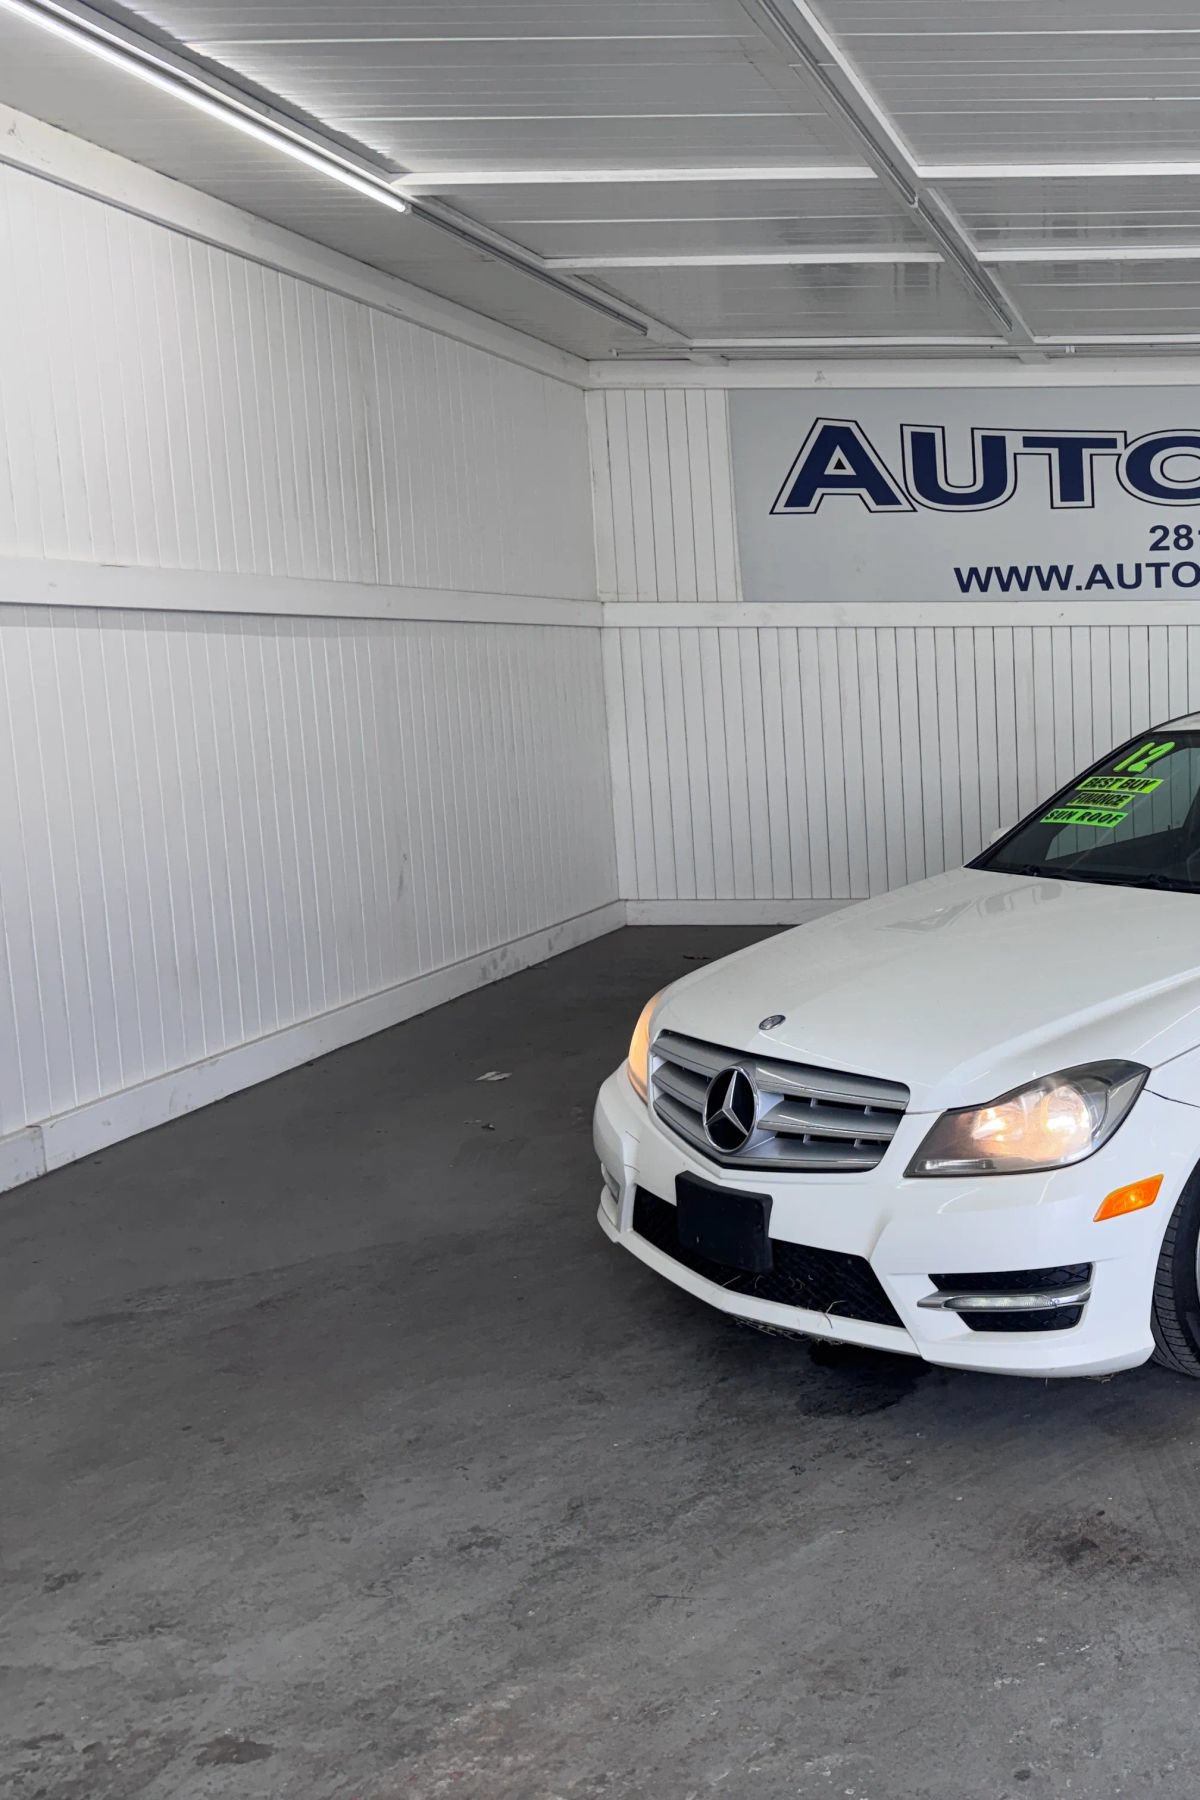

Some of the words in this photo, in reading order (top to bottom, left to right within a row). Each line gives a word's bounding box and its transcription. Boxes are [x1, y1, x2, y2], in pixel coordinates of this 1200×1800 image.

[1113, 742, 1175, 772] 12
[1083, 777, 1122, 789] BEST
[1118, 779, 1157, 791] BUY
[1074, 793, 1131, 807] FINANCE
[1045, 810, 1078, 821] SUN
[1075, 811, 1123, 824] ROOF
